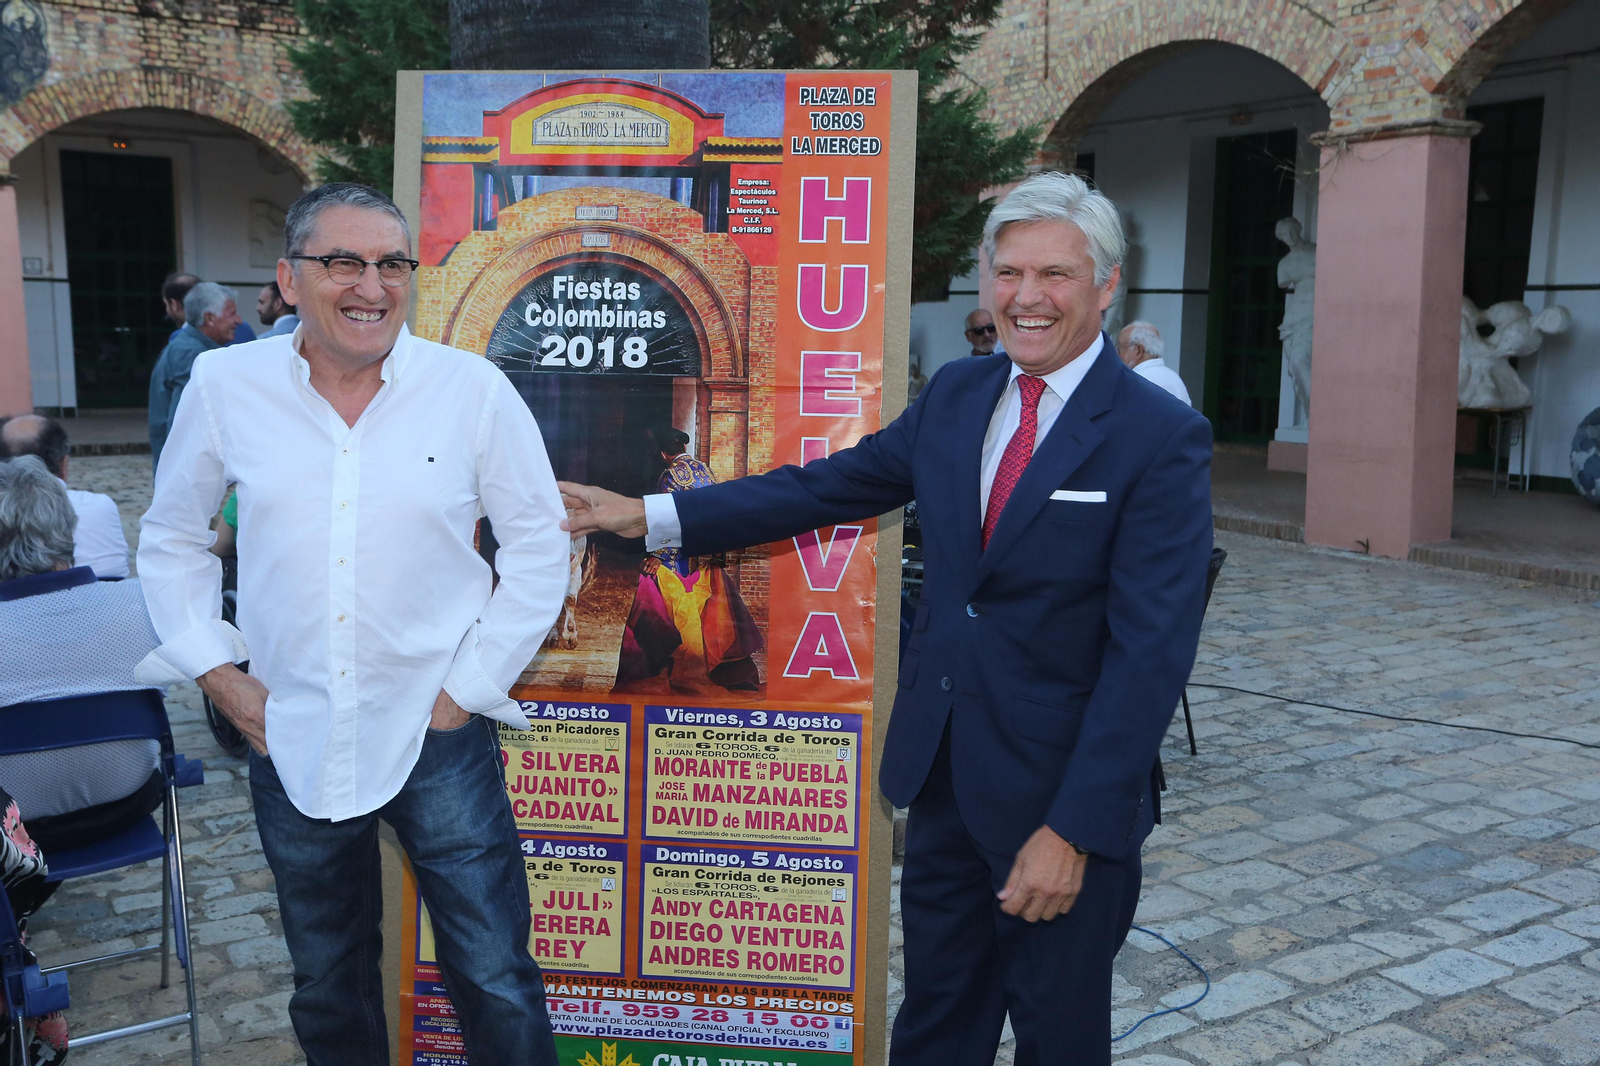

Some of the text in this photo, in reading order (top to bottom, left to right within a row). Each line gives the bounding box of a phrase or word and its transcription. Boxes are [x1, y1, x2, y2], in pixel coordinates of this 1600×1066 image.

[799, 86, 876, 106] PLAZA DE
[580, 110, 597, 119] 1902
[607, 110, 625, 119] 1984
[809, 111, 864, 131] TOROS
[542, 121, 662, 138] PLAZA TOROS LA MERCED
[791, 136, 881, 156] LA MERCED
[730, 188, 777, 196] Espectáculos
[737, 178, 770, 187] Empresa:
[736, 207, 764, 215] Merced,
[738, 197, 768, 205] Taurinos
[552, 275, 641, 300] Fiestas
[524, 302, 666, 329] Colombinas
[540, 335, 649, 368] 2018
[521, 701, 610, 721] 2 Agosto
[665, 708, 842, 730] Viernes, 3 Agosto
[556, 723, 620, 736] Picadores
[654, 727, 851, 746] Gran Corrida de Toros
[695, 750, 730, 758] PEDRO
[732, 751, 779, 761] DOMECQ,
[713, 742, 761, 752] TOROS,
[521, 750, 621, 774] SILVERA
[654, 756, 849, 784] MORANTE de PUEBLA
[757, 771, 766, 780] la
[655, 791, 689, 801] MARIA
[658, 781, 848, 809] JOSE MANZANARES
[512, 799, 620, 823] CADAVAL
[652, 805, 849, 834] DAVID de MIRANDA
[564, 823, 594, 831] cuadrillas
[521, 839, 608, 859] 4 Agosto
[656, 847, 844, 871] Domingo, 5 Agosto
[542, 860, 564, 872] de
[568, 861, 617, 875] Toros
[652, 866, 846, 887] Gran Corrida de Rejones
[651, 887, 679, 895] «LOS
[694, 881, 711, 889] 6
[713, 882, 760, 893] TOROS,
[763, 885, 779, 893] 6
[542, 890, 613, 912] JULI»
[650, 896, 845, 926] ANDY CARTAGENA
[530, 913, 611, 937] ERERA
[650, 920, 845, 951] DIEGO VENTURA
[534, 938, 587, 960] REY
[560, 961, 590, 969] cuadrillas
[648, 945, 845, 975] ANDRES ROMERO
[544, 983, 855, 1014] MANTENEMOS LOS PRECIOS
[565, 976, 628, 987] FESTEJOS
[631, 980, 718, 994] COMENZARAN
[721, 985, 730, 994] A
[734, 986, 758, 995] LAS
[761, 988, 769, 997] 8
[772, 988, 789, 998] DE
[793, 989, 809, 999] LA
[812, 991, 854, 1002] TARDE
[546, 998, 830, 1029] Telf. 959 28 15 00
[549, 1013, 572, 1021] ENTA
[574, 1015, 608, 1024] ONLINE
[610, 1017, 623, 1025] DE
[624, 1018, 689, 1029] LOCALIDADES
[691, 1023, 725, 1032] (CANAL
[727, 1025, 764, 1034] OFICIAL
[774, 1028, 830, 1039] EXCLUSIVO)
[423, 1052, 461, 1060] HORARIO
